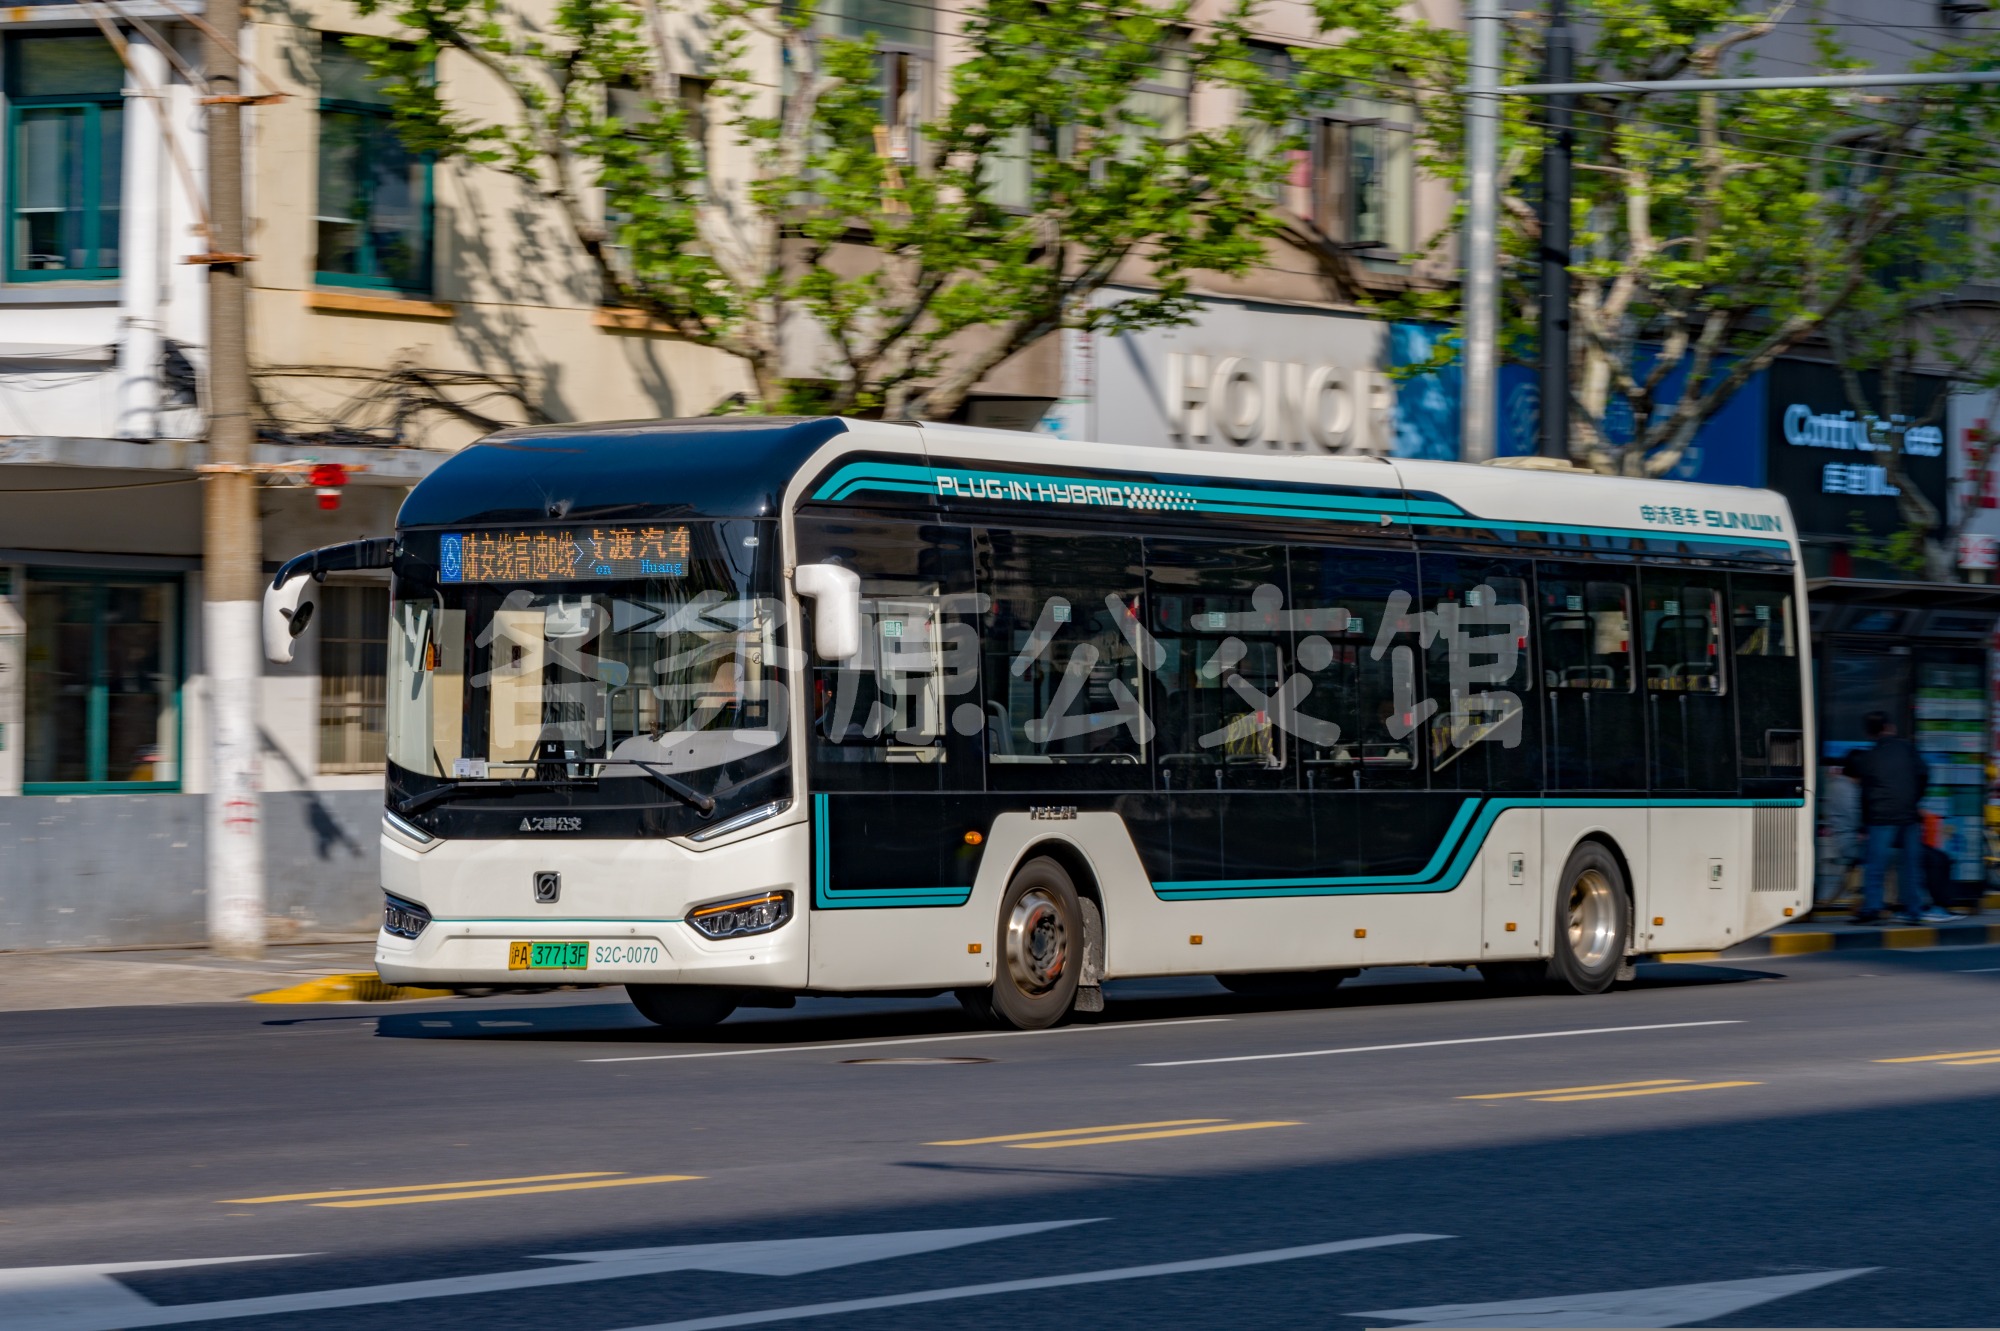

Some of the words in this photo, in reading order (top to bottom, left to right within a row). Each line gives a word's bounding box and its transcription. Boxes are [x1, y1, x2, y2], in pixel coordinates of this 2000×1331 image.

[1166, 352, 1392, 451] HONOR
[936, 475, 1032, 501] PLUG-IN
[1038, 482, 1125, 506] HYBRID
[1640, 504, 1700, 526] 申沃客车
[1703, 510, 1783, 532] SUNWIN
[595, 946, 659, 964] S2C-0070
